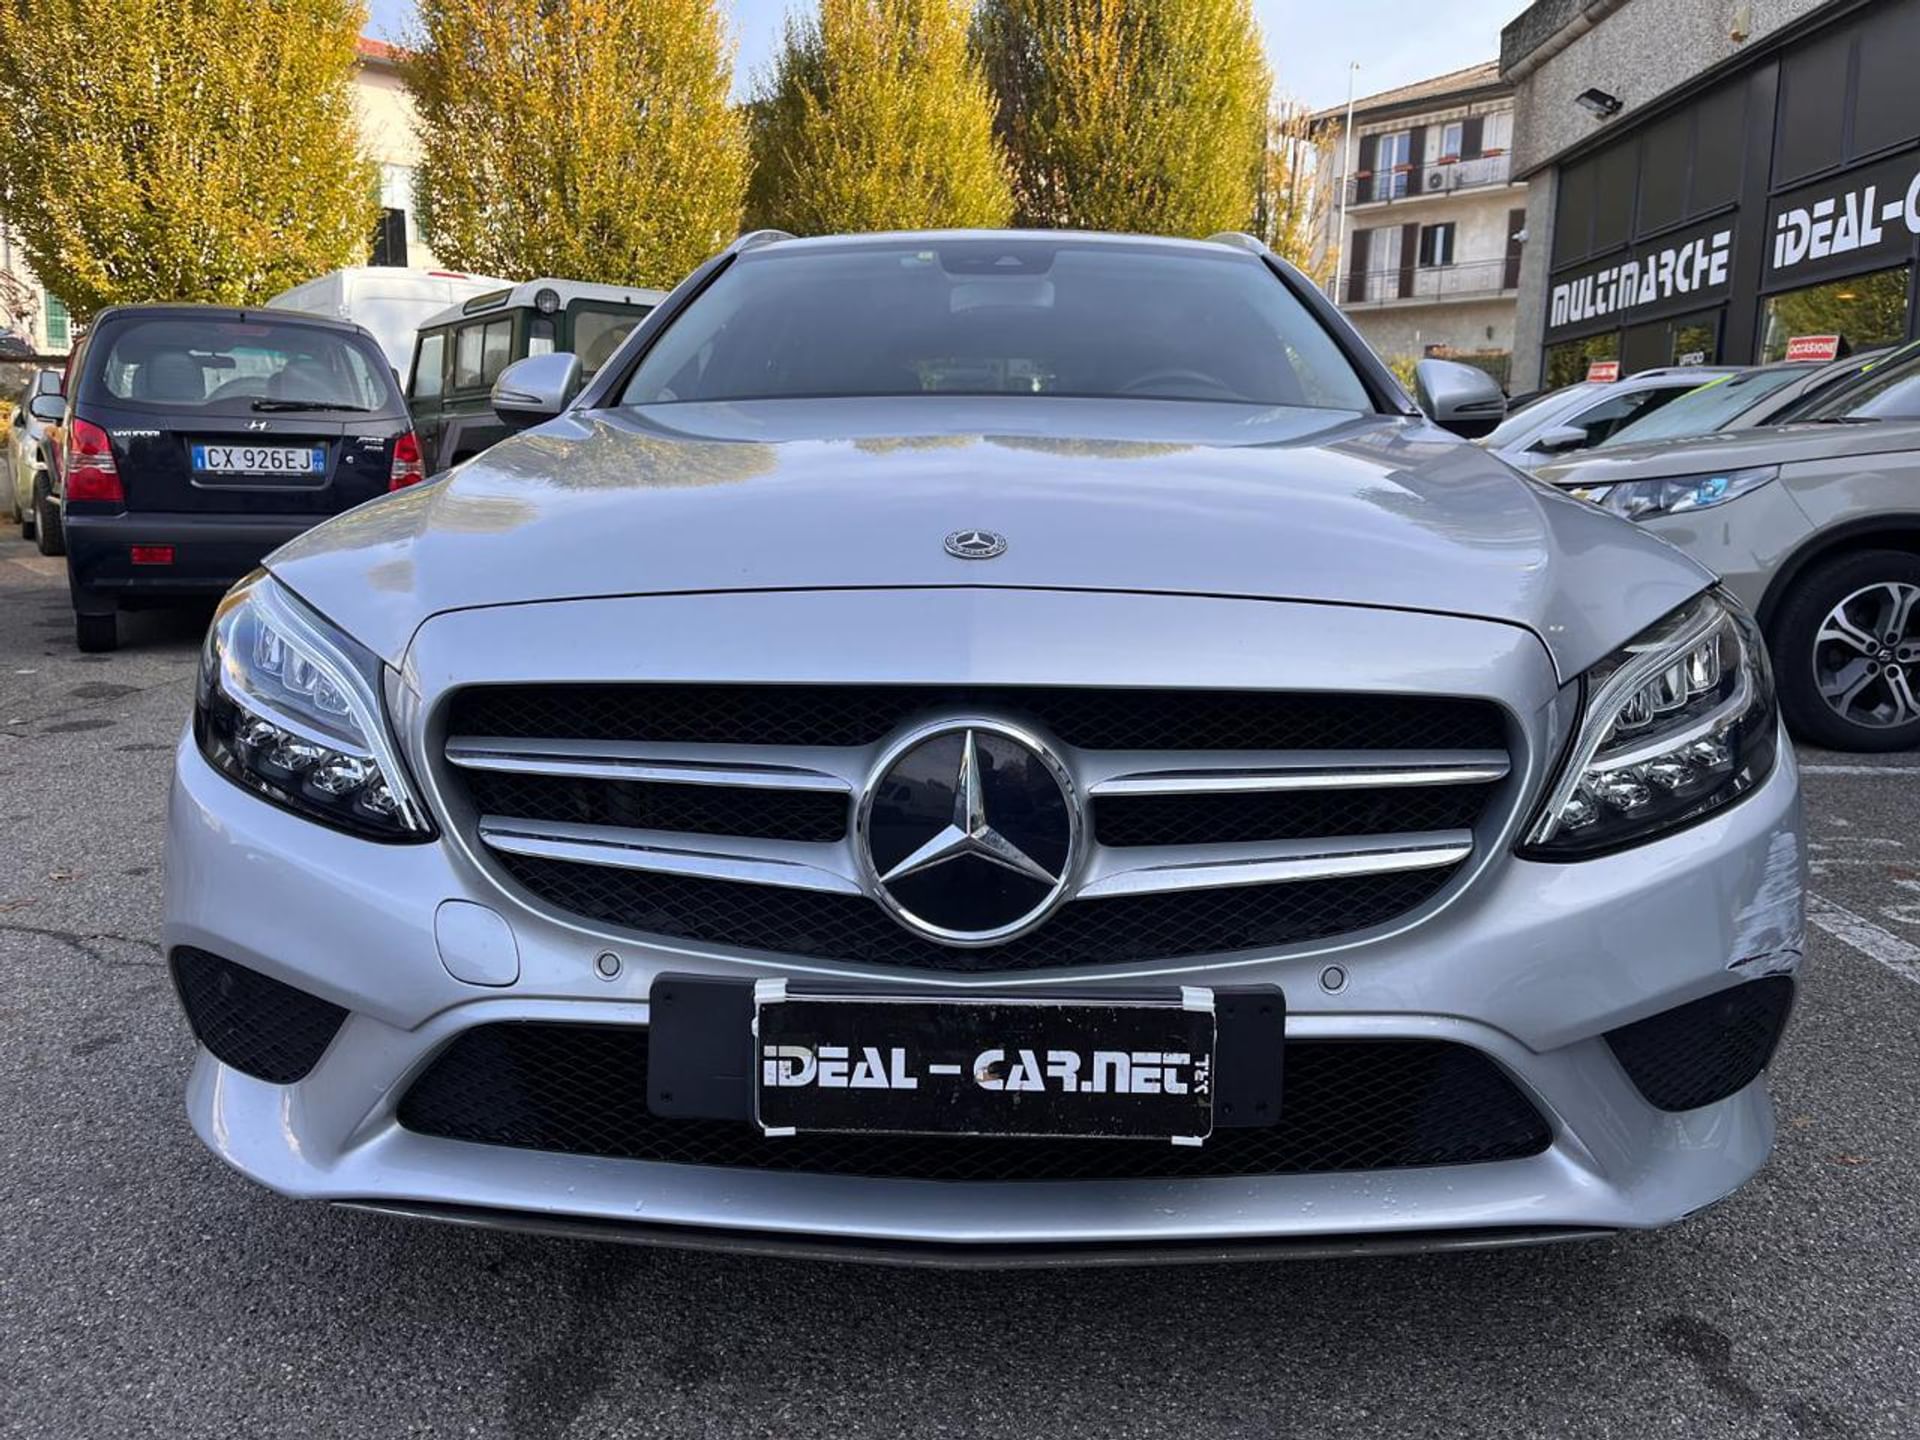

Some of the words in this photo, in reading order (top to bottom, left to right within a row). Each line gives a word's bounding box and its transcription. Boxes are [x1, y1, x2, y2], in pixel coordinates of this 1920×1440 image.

[1550, 230, 1732, 328] MULTIMARCHE
[208, 448, 235, 469] CX
[243, 449, 310, 470] 926EJ
